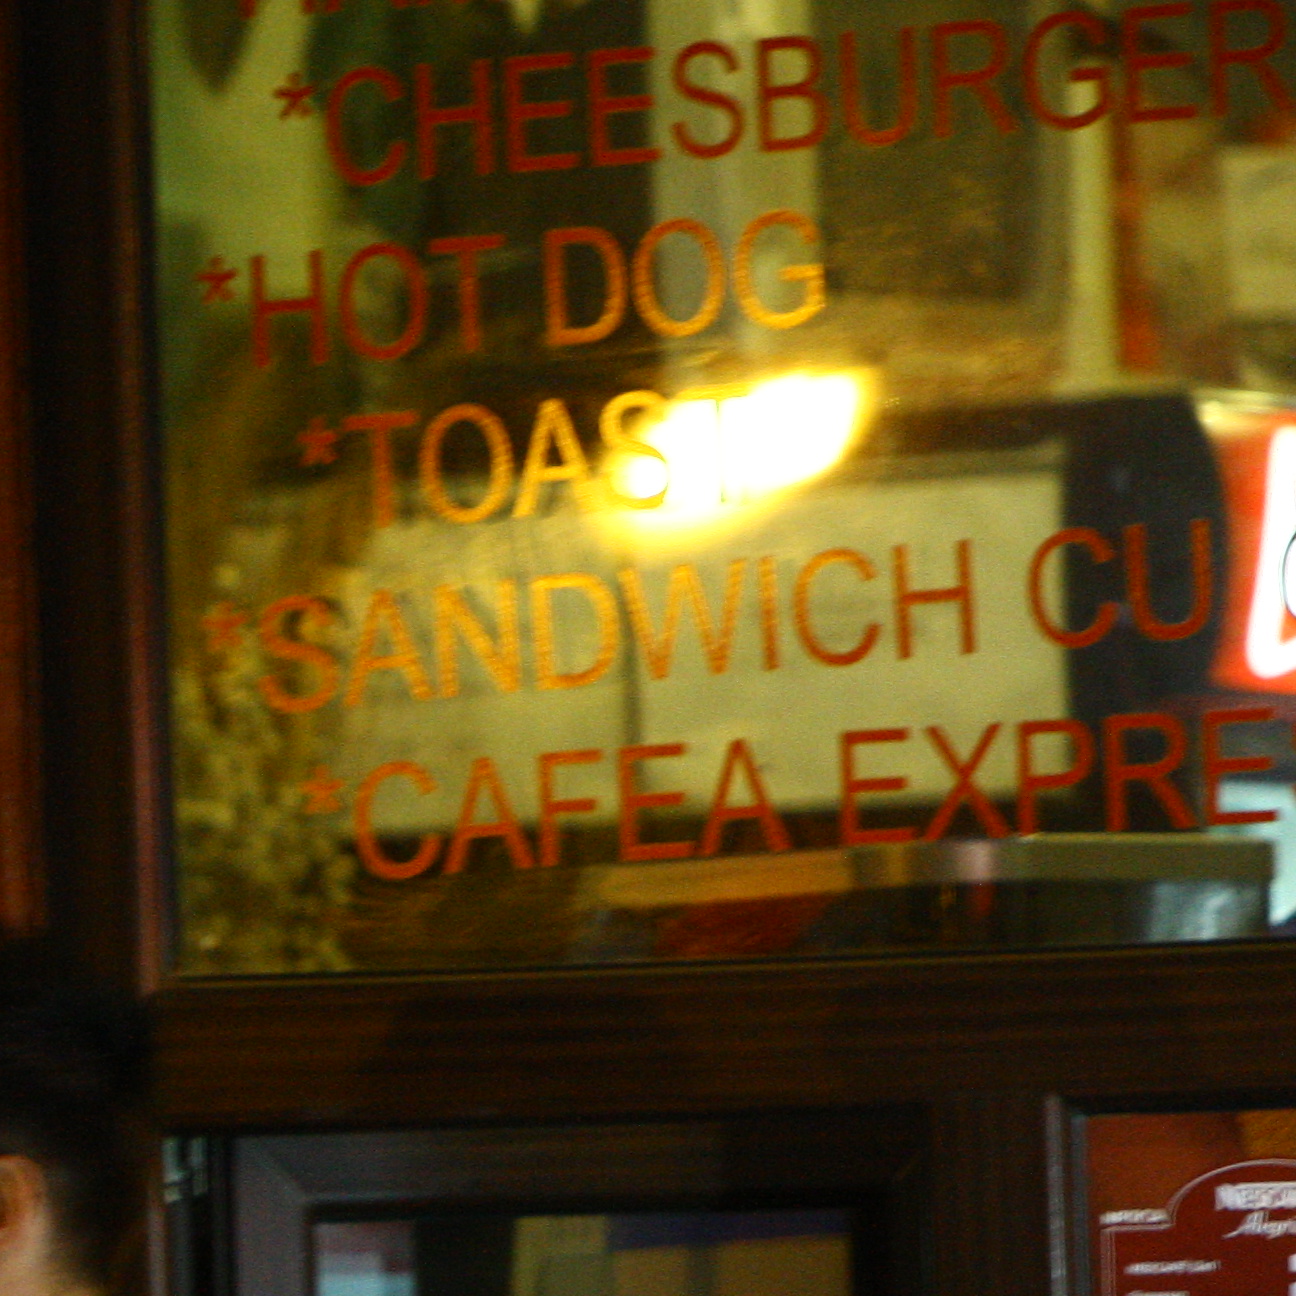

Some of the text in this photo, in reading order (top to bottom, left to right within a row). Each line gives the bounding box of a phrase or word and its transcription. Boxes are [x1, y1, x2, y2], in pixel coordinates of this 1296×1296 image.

[543, 209, 828, 349] DOG
[1026, 519, 1214, 651] CU
[838, 706, 1296, 848] EXPRE
